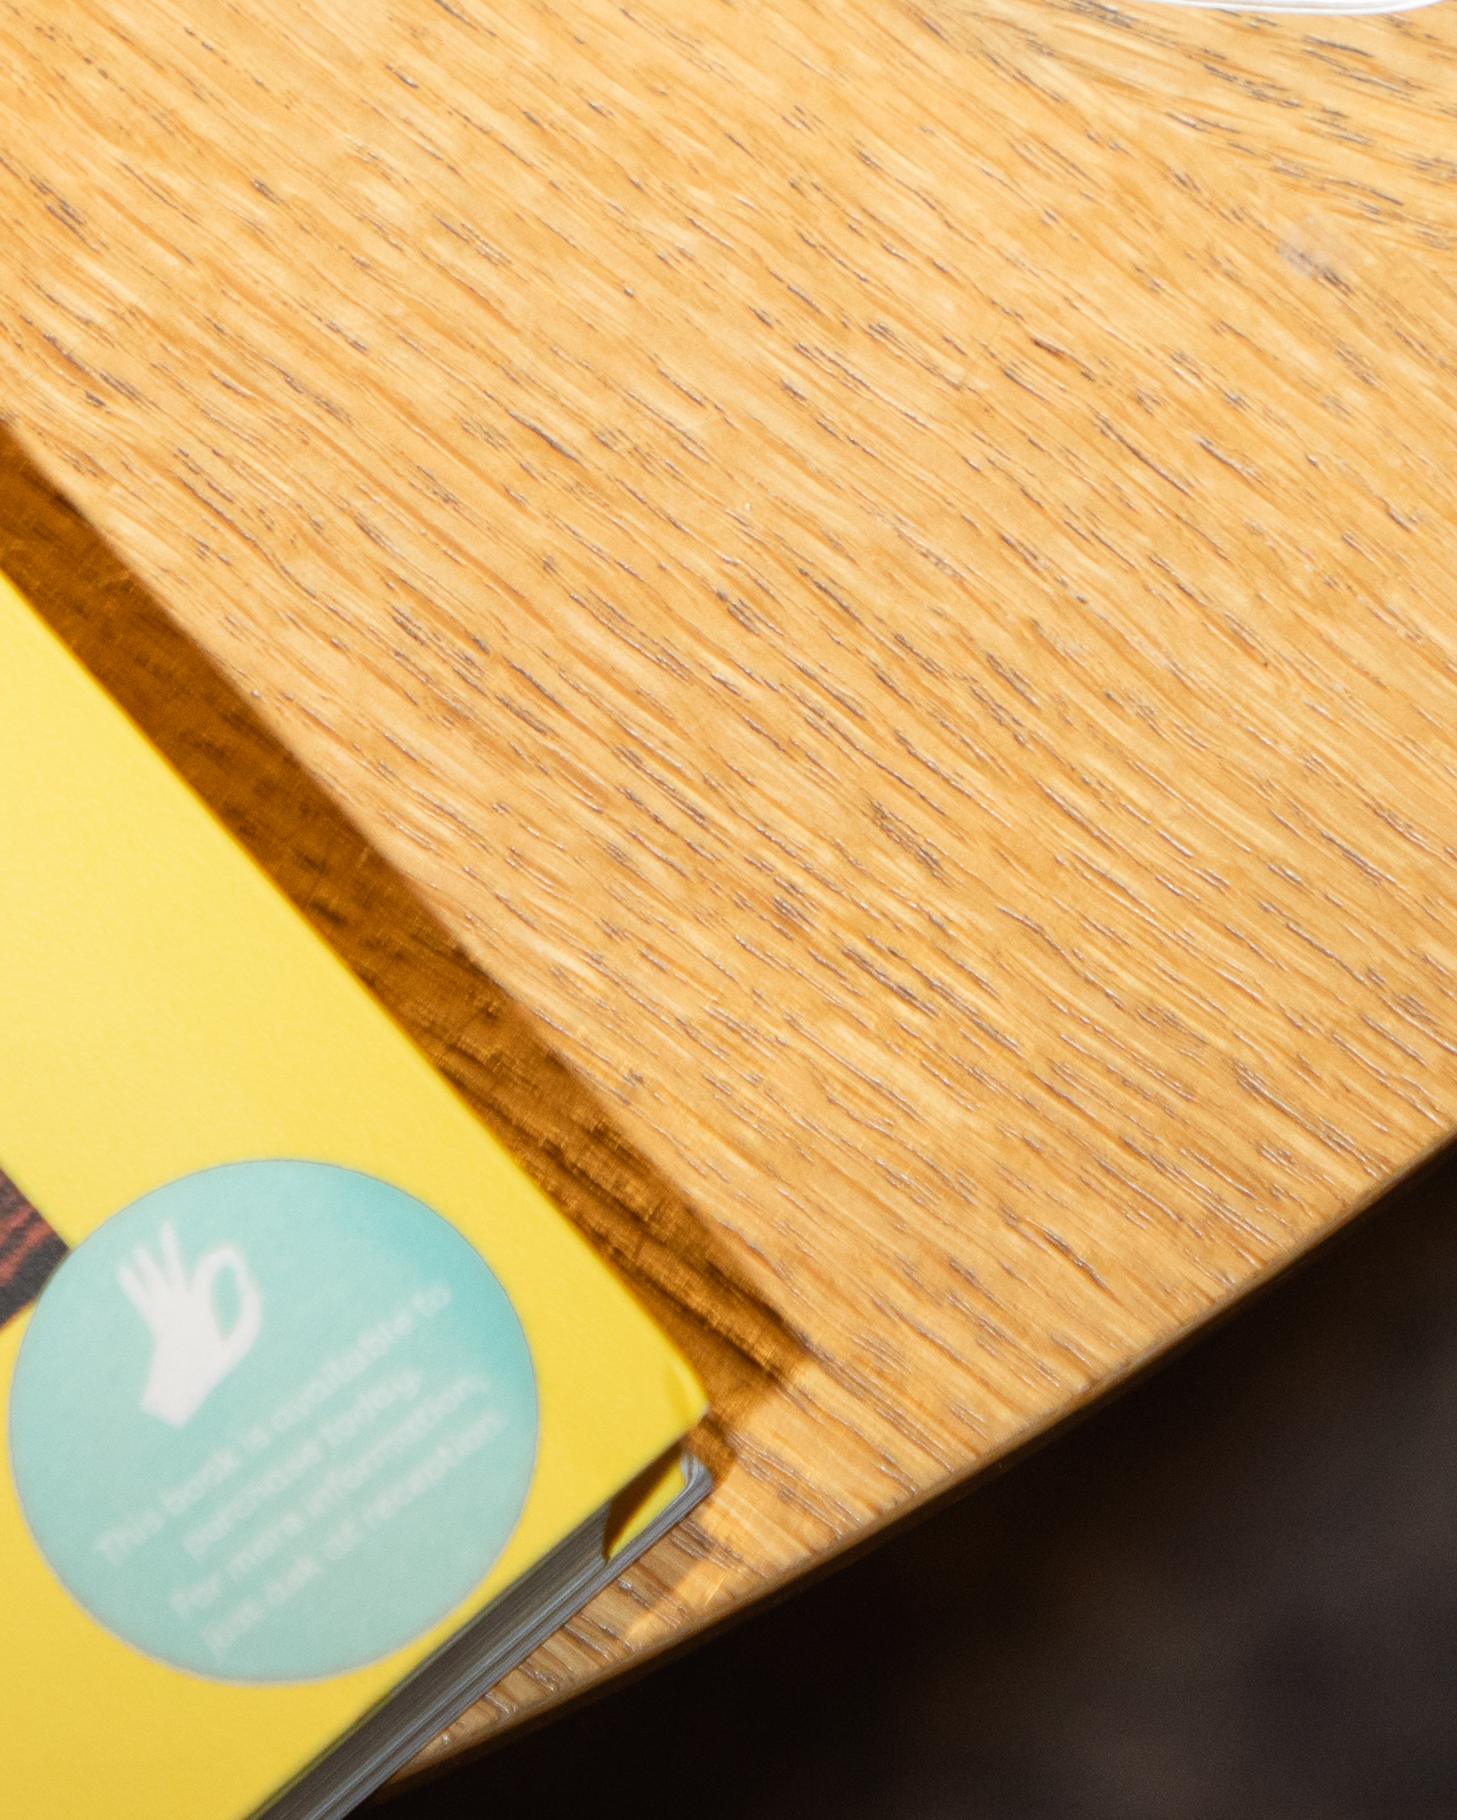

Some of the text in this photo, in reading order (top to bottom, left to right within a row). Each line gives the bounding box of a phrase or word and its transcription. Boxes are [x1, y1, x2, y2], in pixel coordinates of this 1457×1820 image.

[93, 1278, 452, 1567] This book is available to
[183, 1440, 320, 1561] purchase
[168, 1573, 219, 1623] For
[226, 1512, 305, 1578] more
[264, 1555, 323, 1608] ask
[323, 1519, 365, 1559] at
